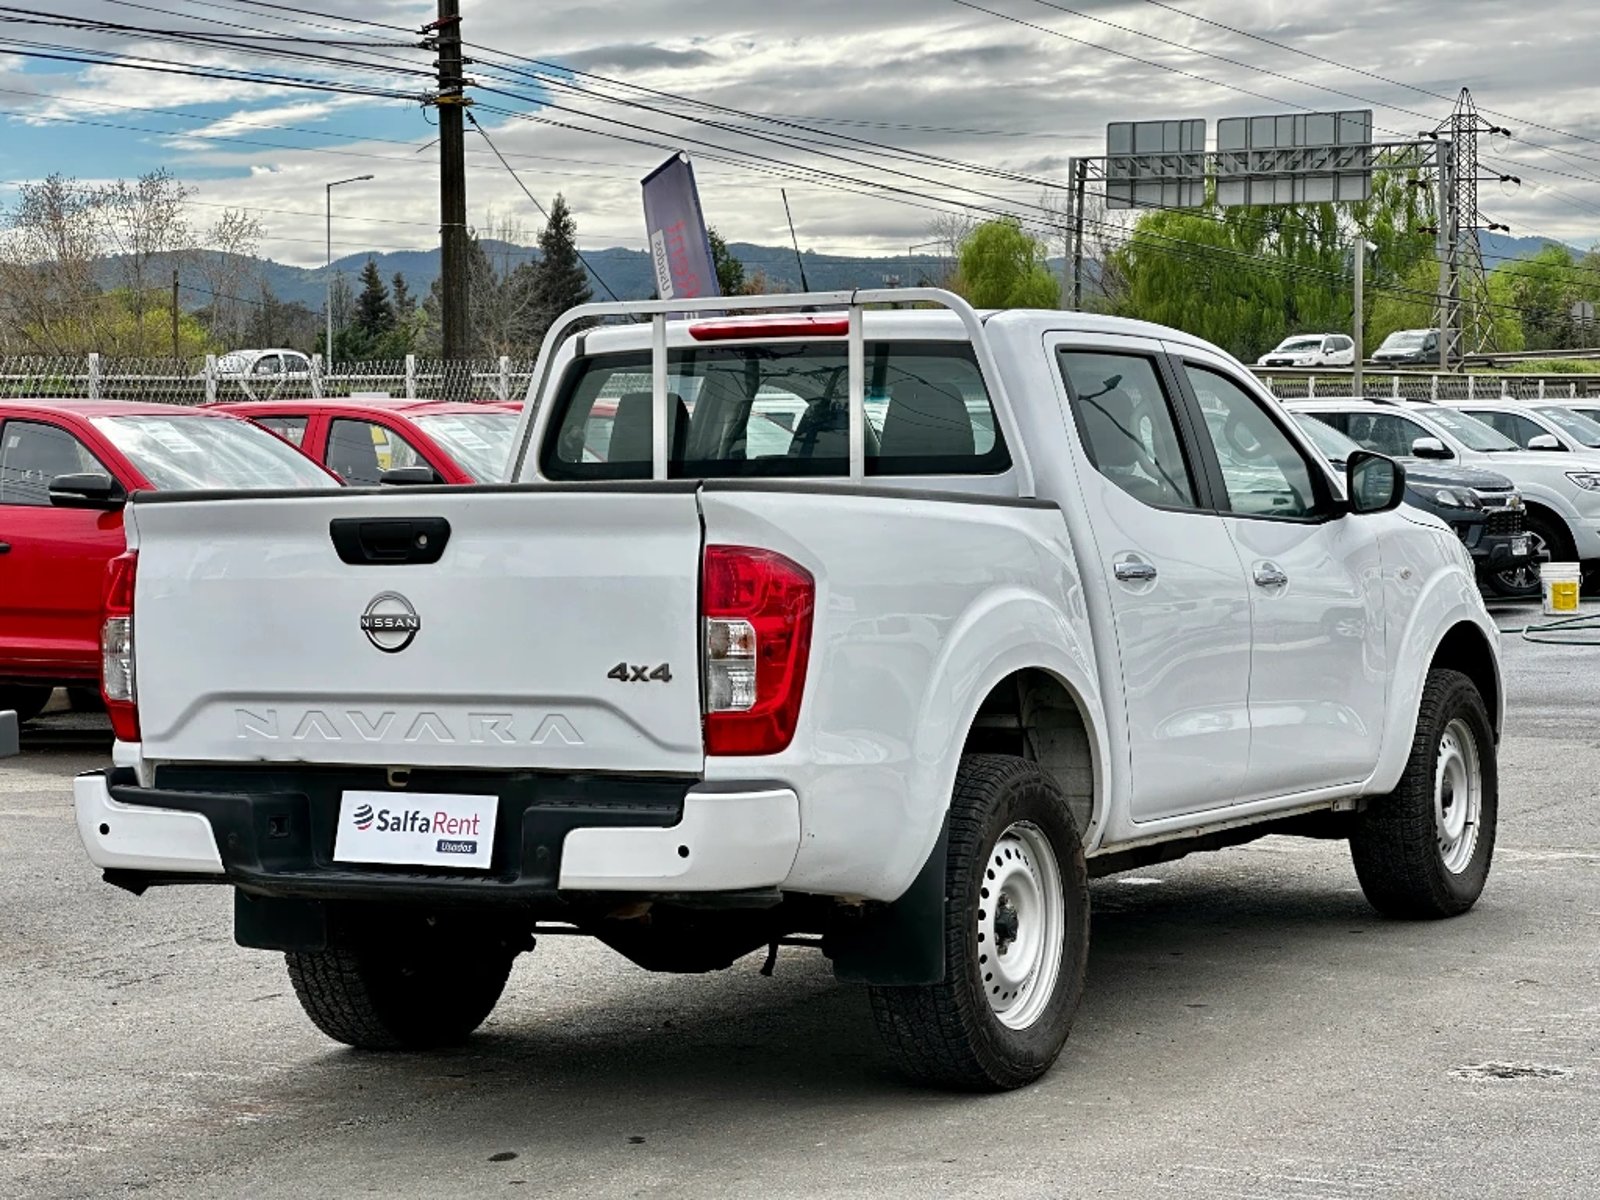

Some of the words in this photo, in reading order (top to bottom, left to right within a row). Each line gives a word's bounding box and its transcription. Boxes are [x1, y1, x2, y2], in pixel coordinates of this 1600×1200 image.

[361, 617, 417, 628] NISSAN
[607, 662, 673, 682] 4x4
[234, 708, 585, 745] NAVARA
[376, 809, 481, 836] SalfaRent
[441, 842, 473, 852] Usados
